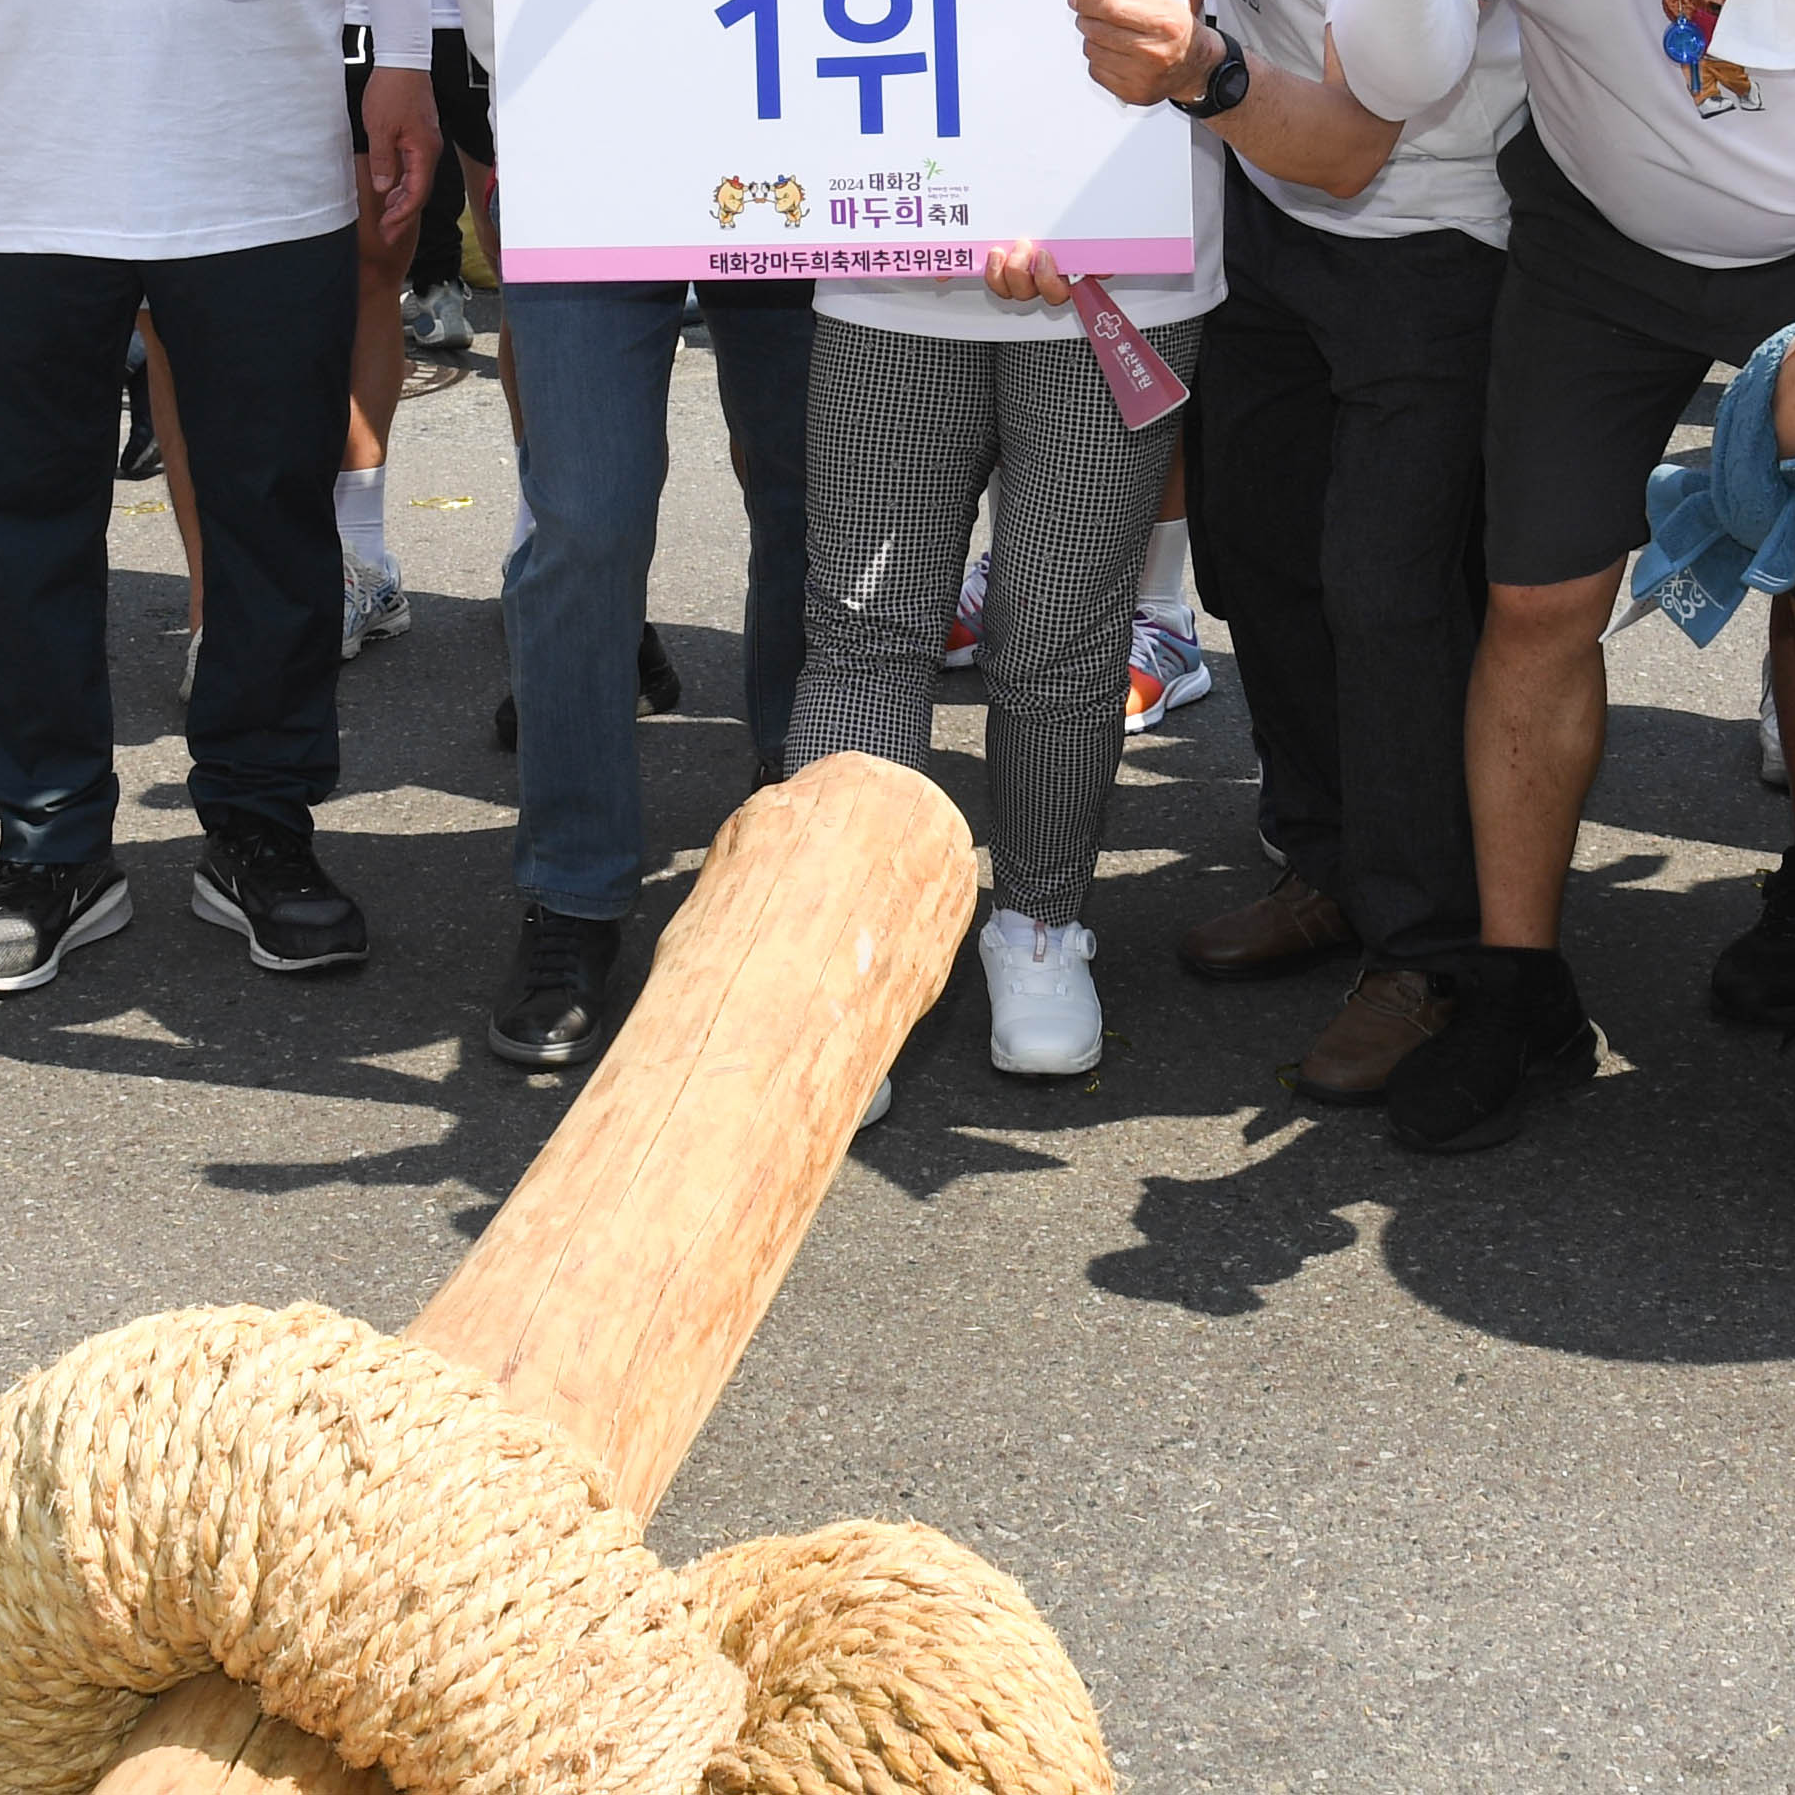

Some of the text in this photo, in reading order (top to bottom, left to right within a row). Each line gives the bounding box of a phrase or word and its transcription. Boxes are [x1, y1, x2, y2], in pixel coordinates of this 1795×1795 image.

[829, 172, 922, 192] 2024 태화강
[829, 195, 969, 229] 마두희 축제
[708, 246, 974, 274] 태화강마두희축제추진위원회
